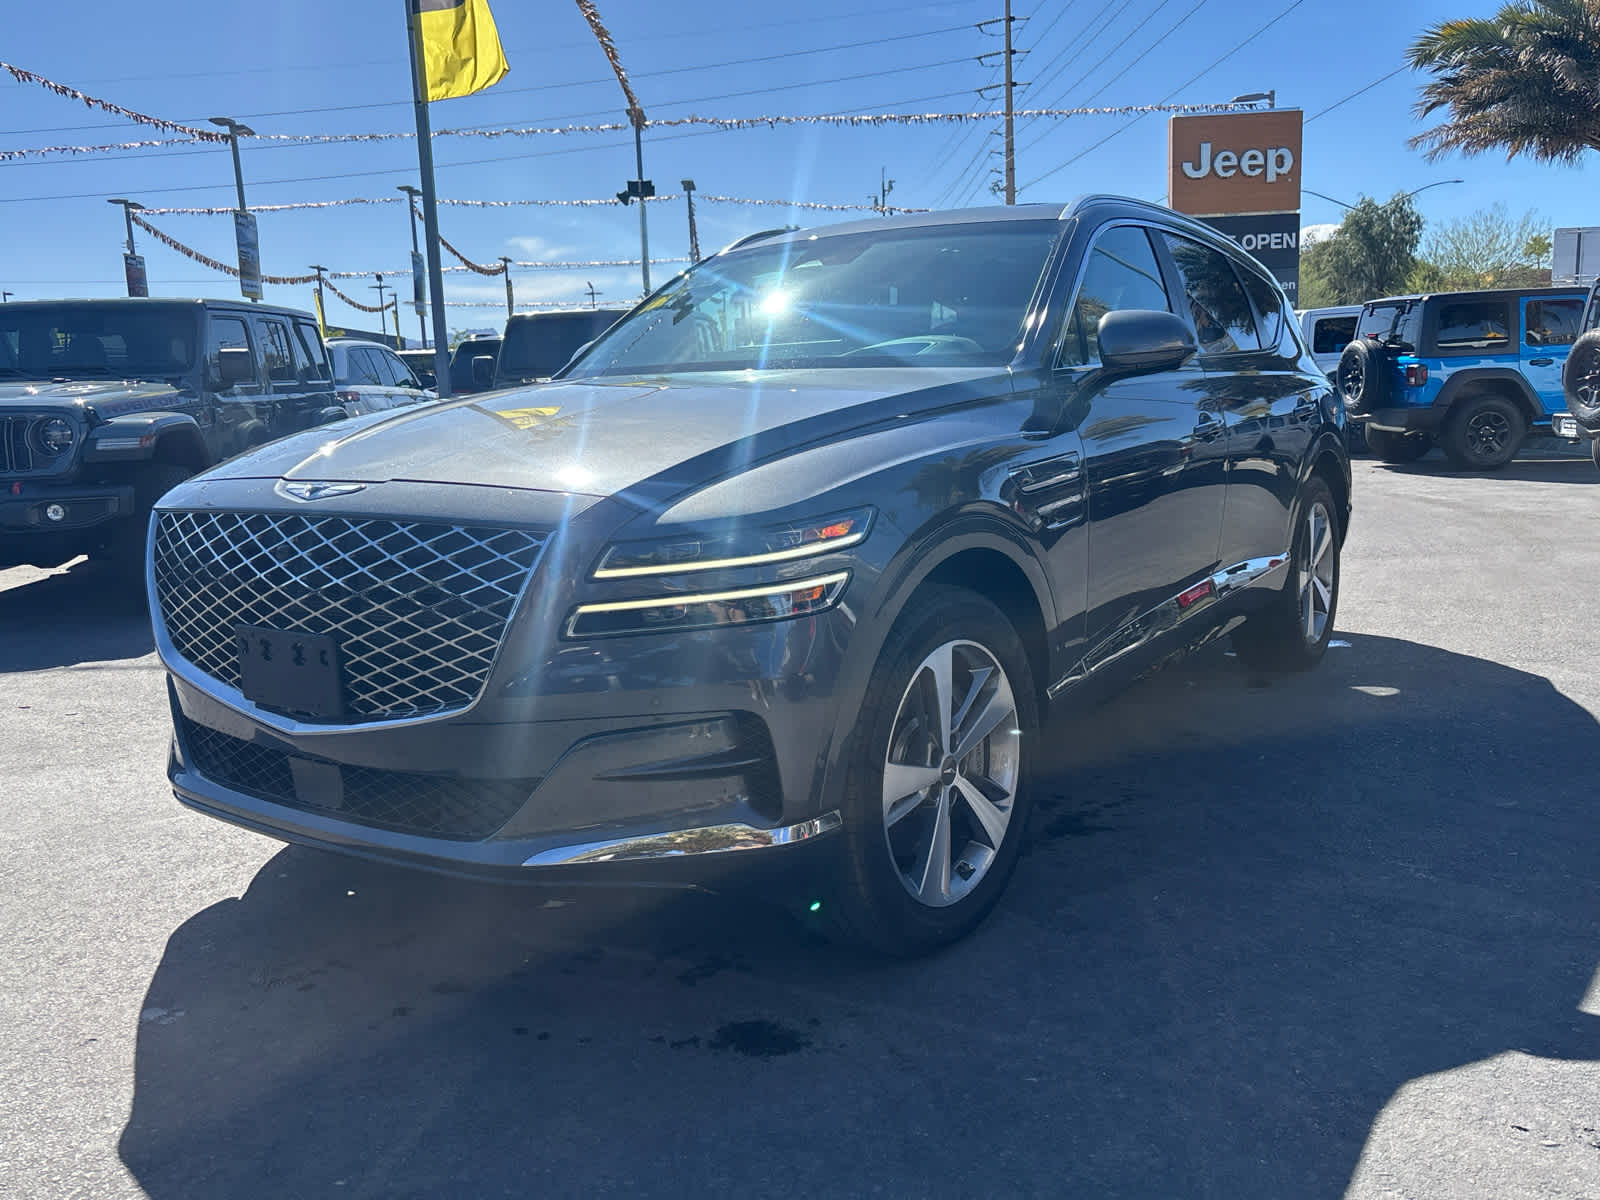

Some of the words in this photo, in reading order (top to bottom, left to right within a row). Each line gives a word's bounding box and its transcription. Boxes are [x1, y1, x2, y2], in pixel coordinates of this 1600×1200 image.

[1182, 141, 1294, 184] Jeep
[1241, 231, 1297, 251] OPEN
[1281, 281, 1296, 290] en
